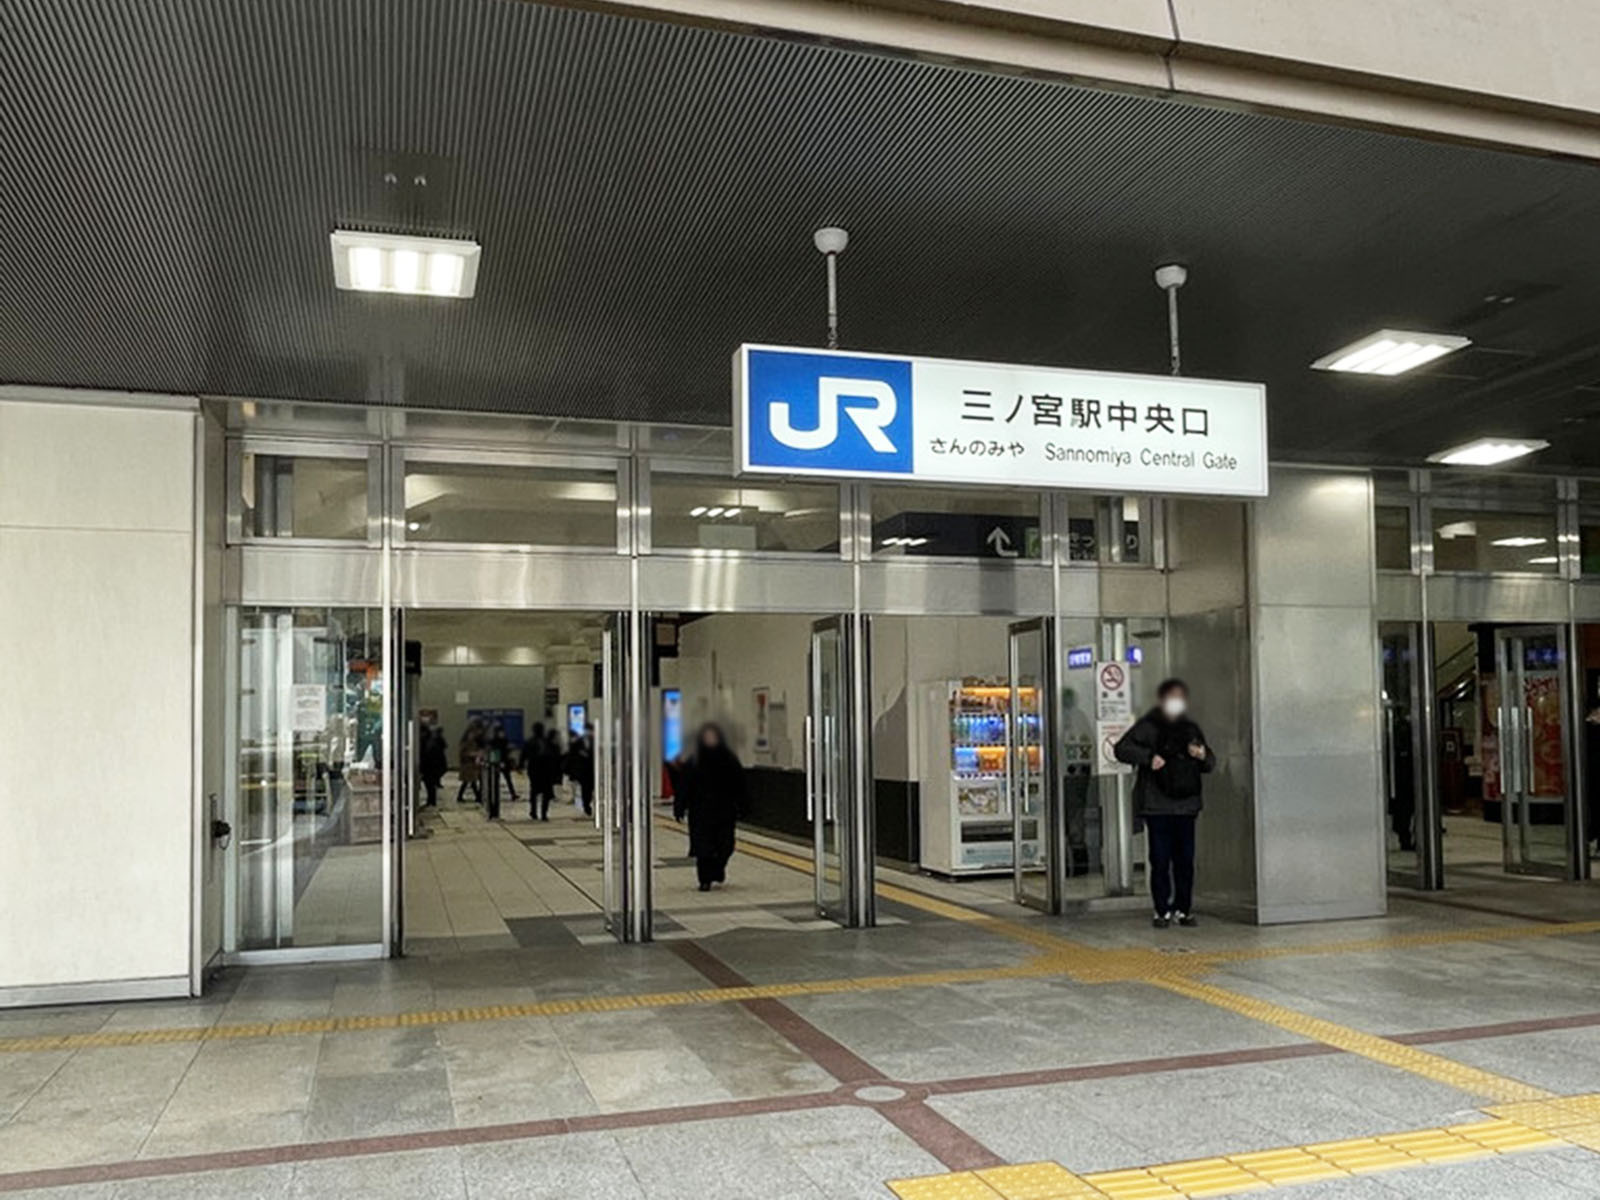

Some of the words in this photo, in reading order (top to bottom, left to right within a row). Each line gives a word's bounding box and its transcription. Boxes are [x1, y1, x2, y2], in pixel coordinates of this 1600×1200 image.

[768, 376, 898, 453] JR
[961, 388, 1210, 437] 三ノ宮駅中央口
[929, 437, 1025, 458] さんのみや
[1044, 442, 1132, 467] Sannomiya
[1140, 448, 1195, 468] Central
[1203, 452, 1238, 471] Gate
